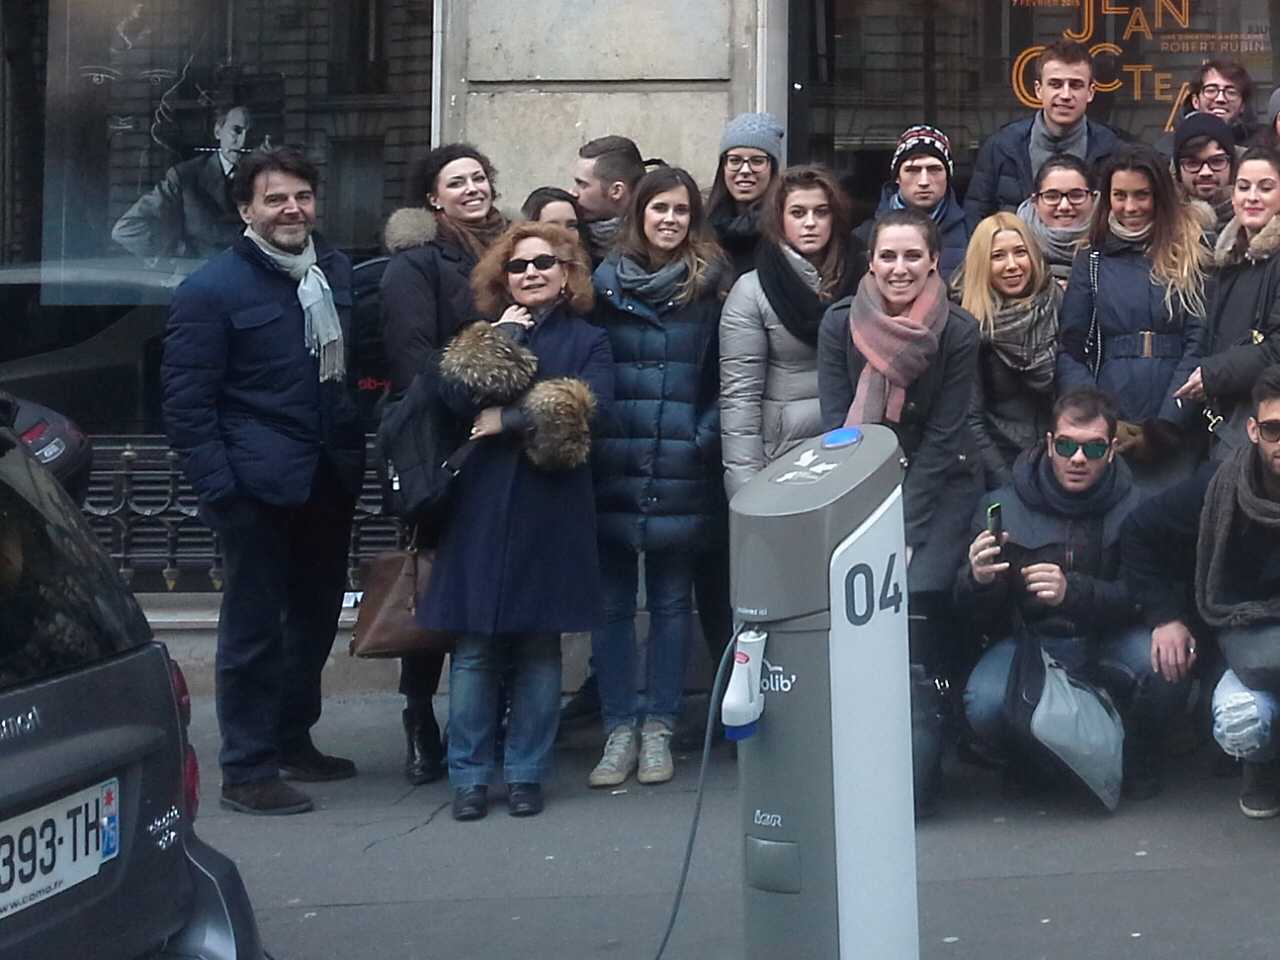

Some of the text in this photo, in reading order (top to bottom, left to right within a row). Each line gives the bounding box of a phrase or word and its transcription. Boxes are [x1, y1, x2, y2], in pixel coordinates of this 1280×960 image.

[1061, 0, 1081, 7] 2015
[1160, 42, 1265, 52] ROBERT RUBIN
[844, 552, 903, 627] 04
[760, 674, 797, 692] olib'
